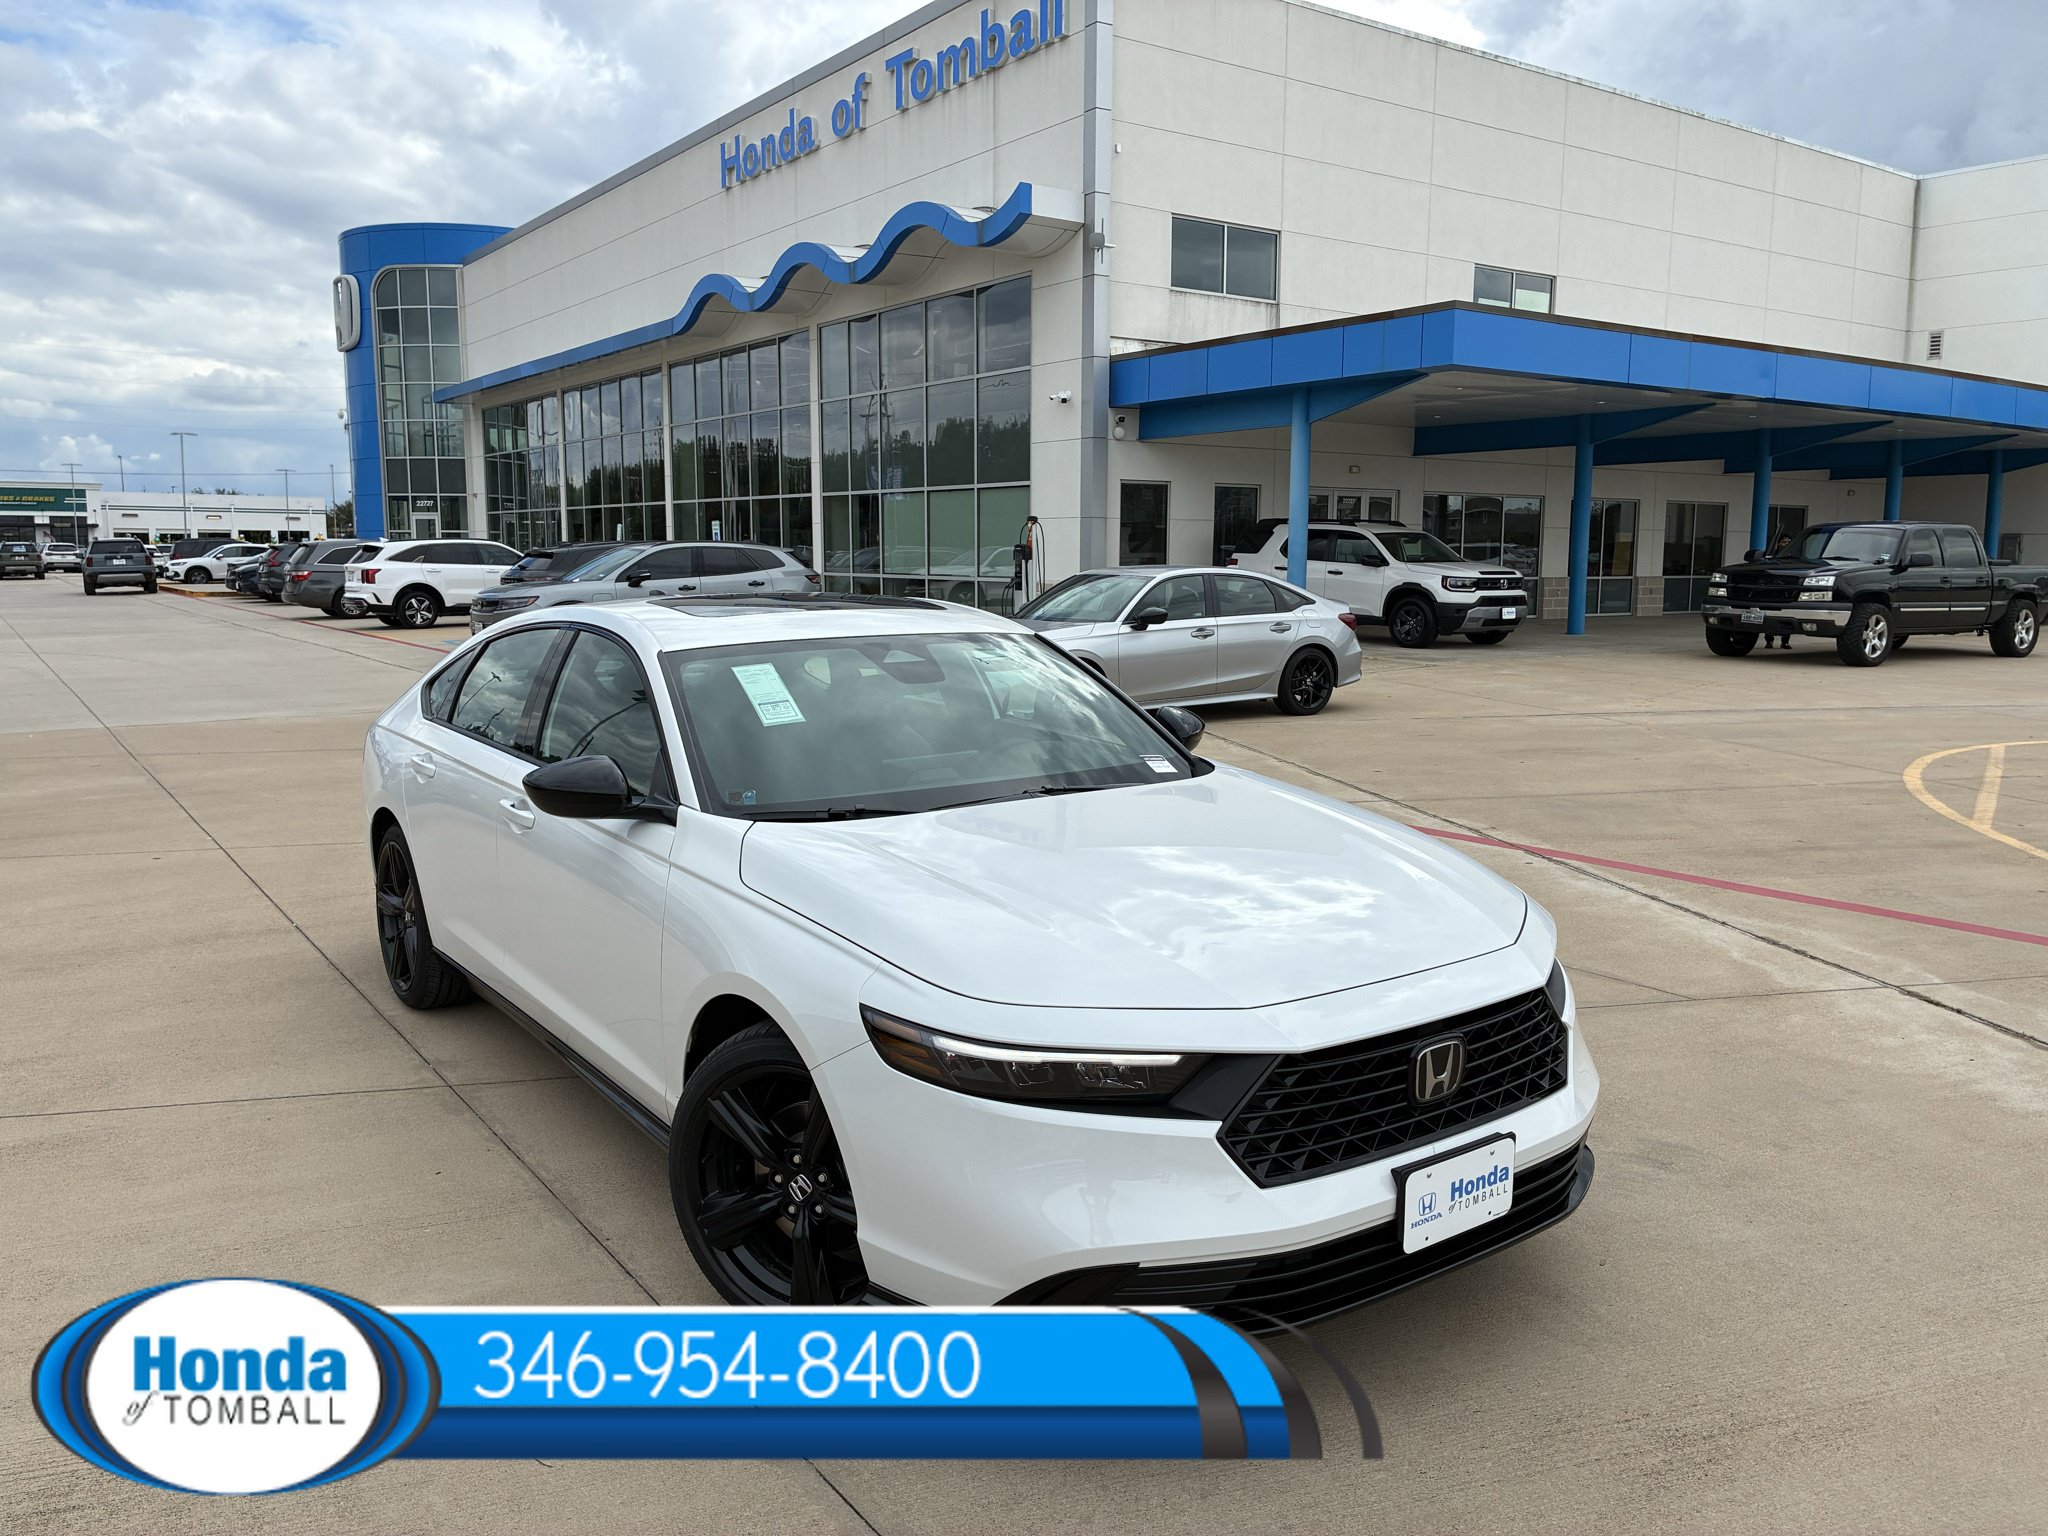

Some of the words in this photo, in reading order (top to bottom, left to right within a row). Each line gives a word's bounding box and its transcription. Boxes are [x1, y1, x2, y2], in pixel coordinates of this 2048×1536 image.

[720, 107, 818, 190] Honda
[831, 71, 871, 139] of
[885, 0, 1068, 112] Tomball
[1450, 1164, 1510, 1203] Honda
[1458, 1183, 1509, 1212] TOMBALL
[1410, 1211, 1443, 1230] HONDA
